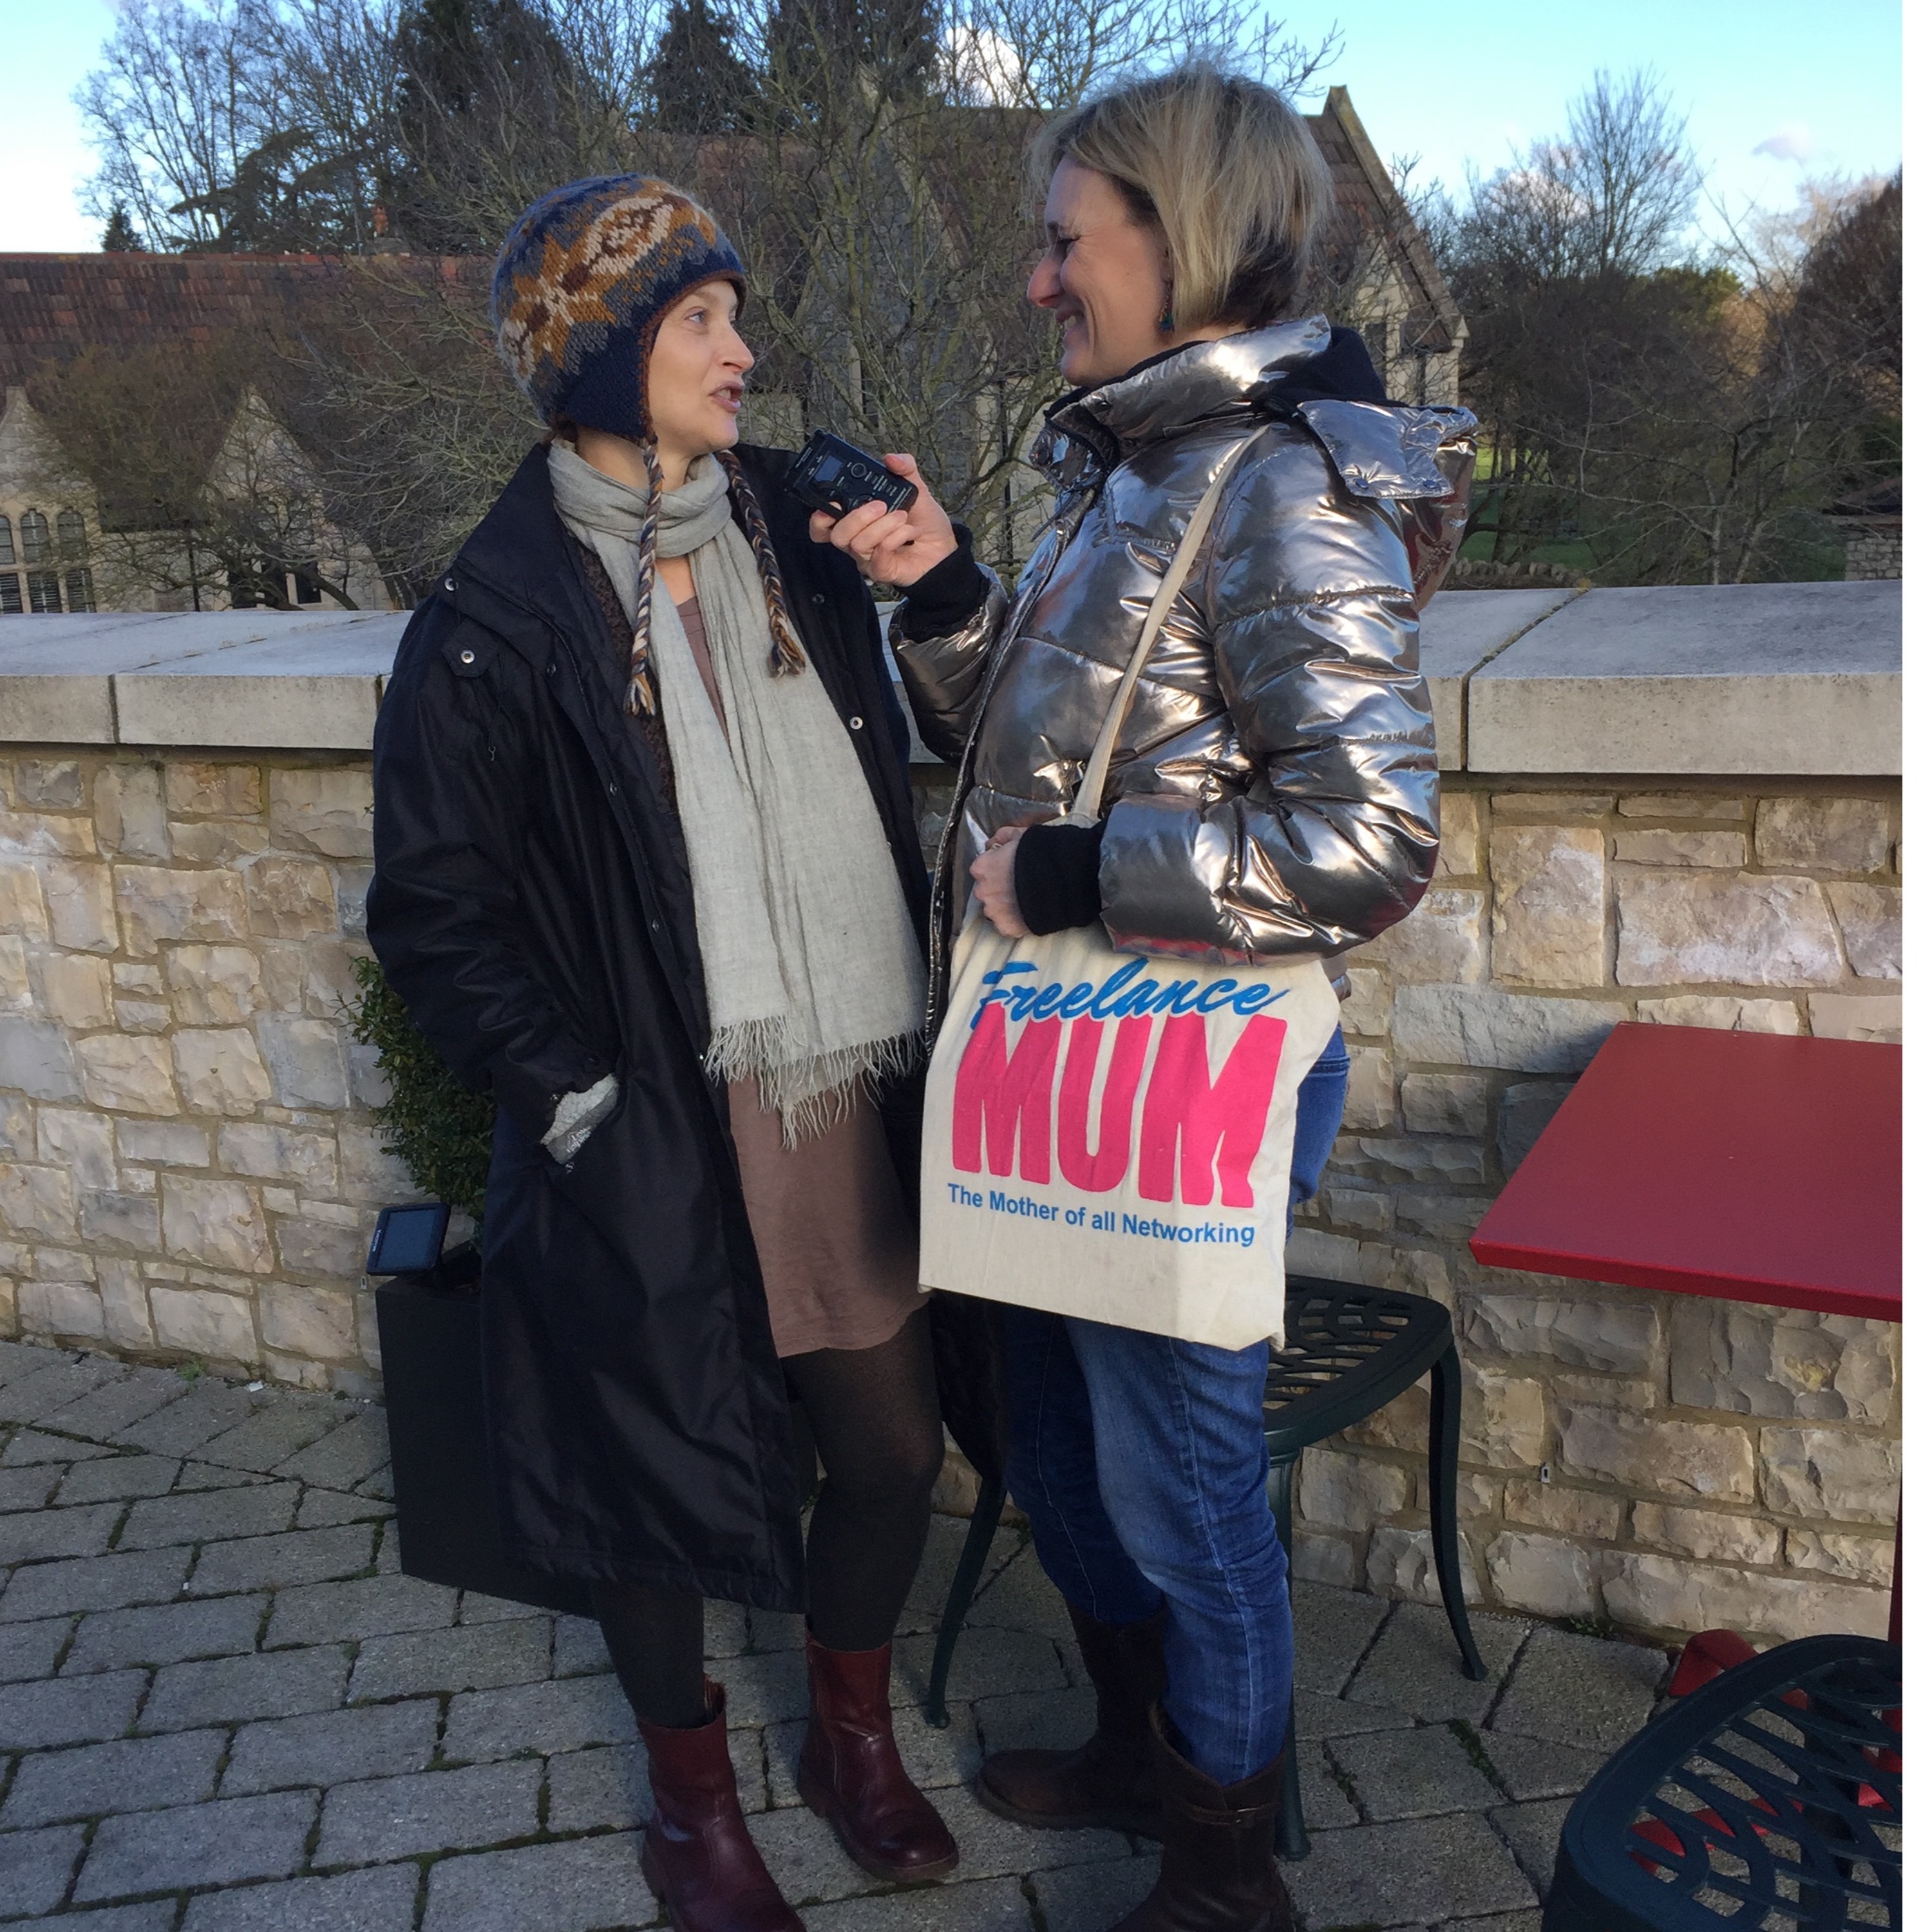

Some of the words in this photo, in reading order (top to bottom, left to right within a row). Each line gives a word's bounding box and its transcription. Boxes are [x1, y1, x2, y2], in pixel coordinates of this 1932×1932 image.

[970, 957, 1290, 1030] Freelance
[952, 1001, 1288, 1208] MUM
[947, 1183, 983, 1208] The
[989, 1190, 1059, 1222] Mother
[1065, 1207, 1087, 1226] of
[1092, 1211, 1116, 1231] all
[1122, 1213, 1256, 1248] Networking
